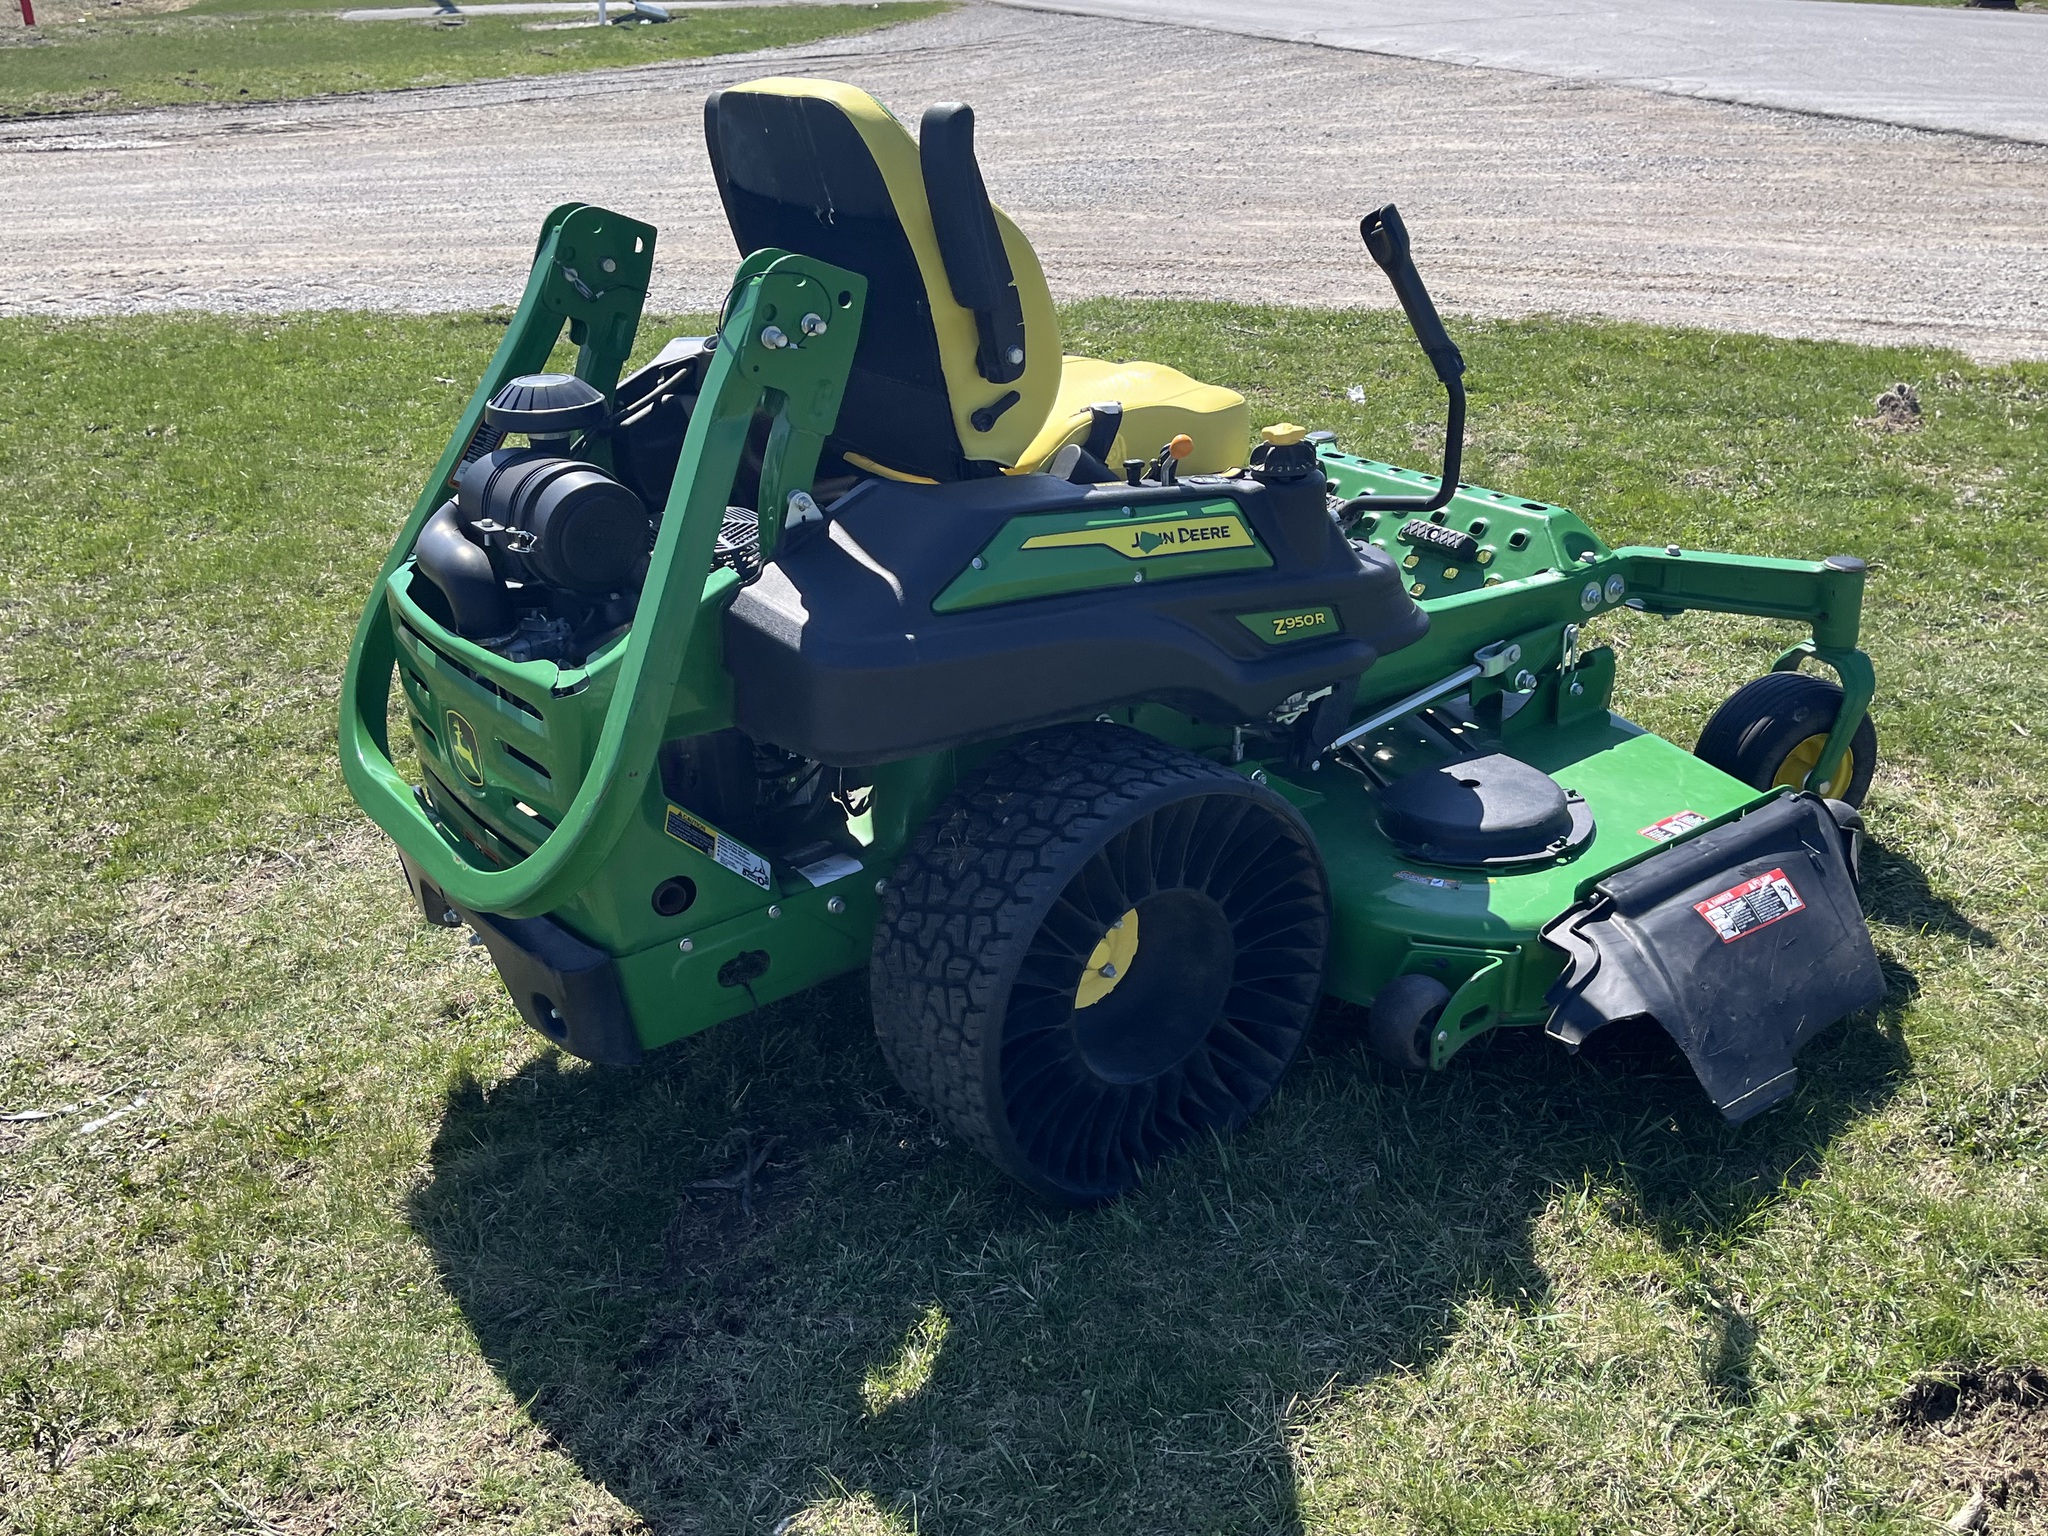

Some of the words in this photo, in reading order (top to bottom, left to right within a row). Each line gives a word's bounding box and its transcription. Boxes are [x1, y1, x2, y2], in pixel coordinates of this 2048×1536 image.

[1131, 531, 1175, 548] JN
[1177, 525, 1231, 543] DEERE
[1272, 612, 1326, 636] Z950R
